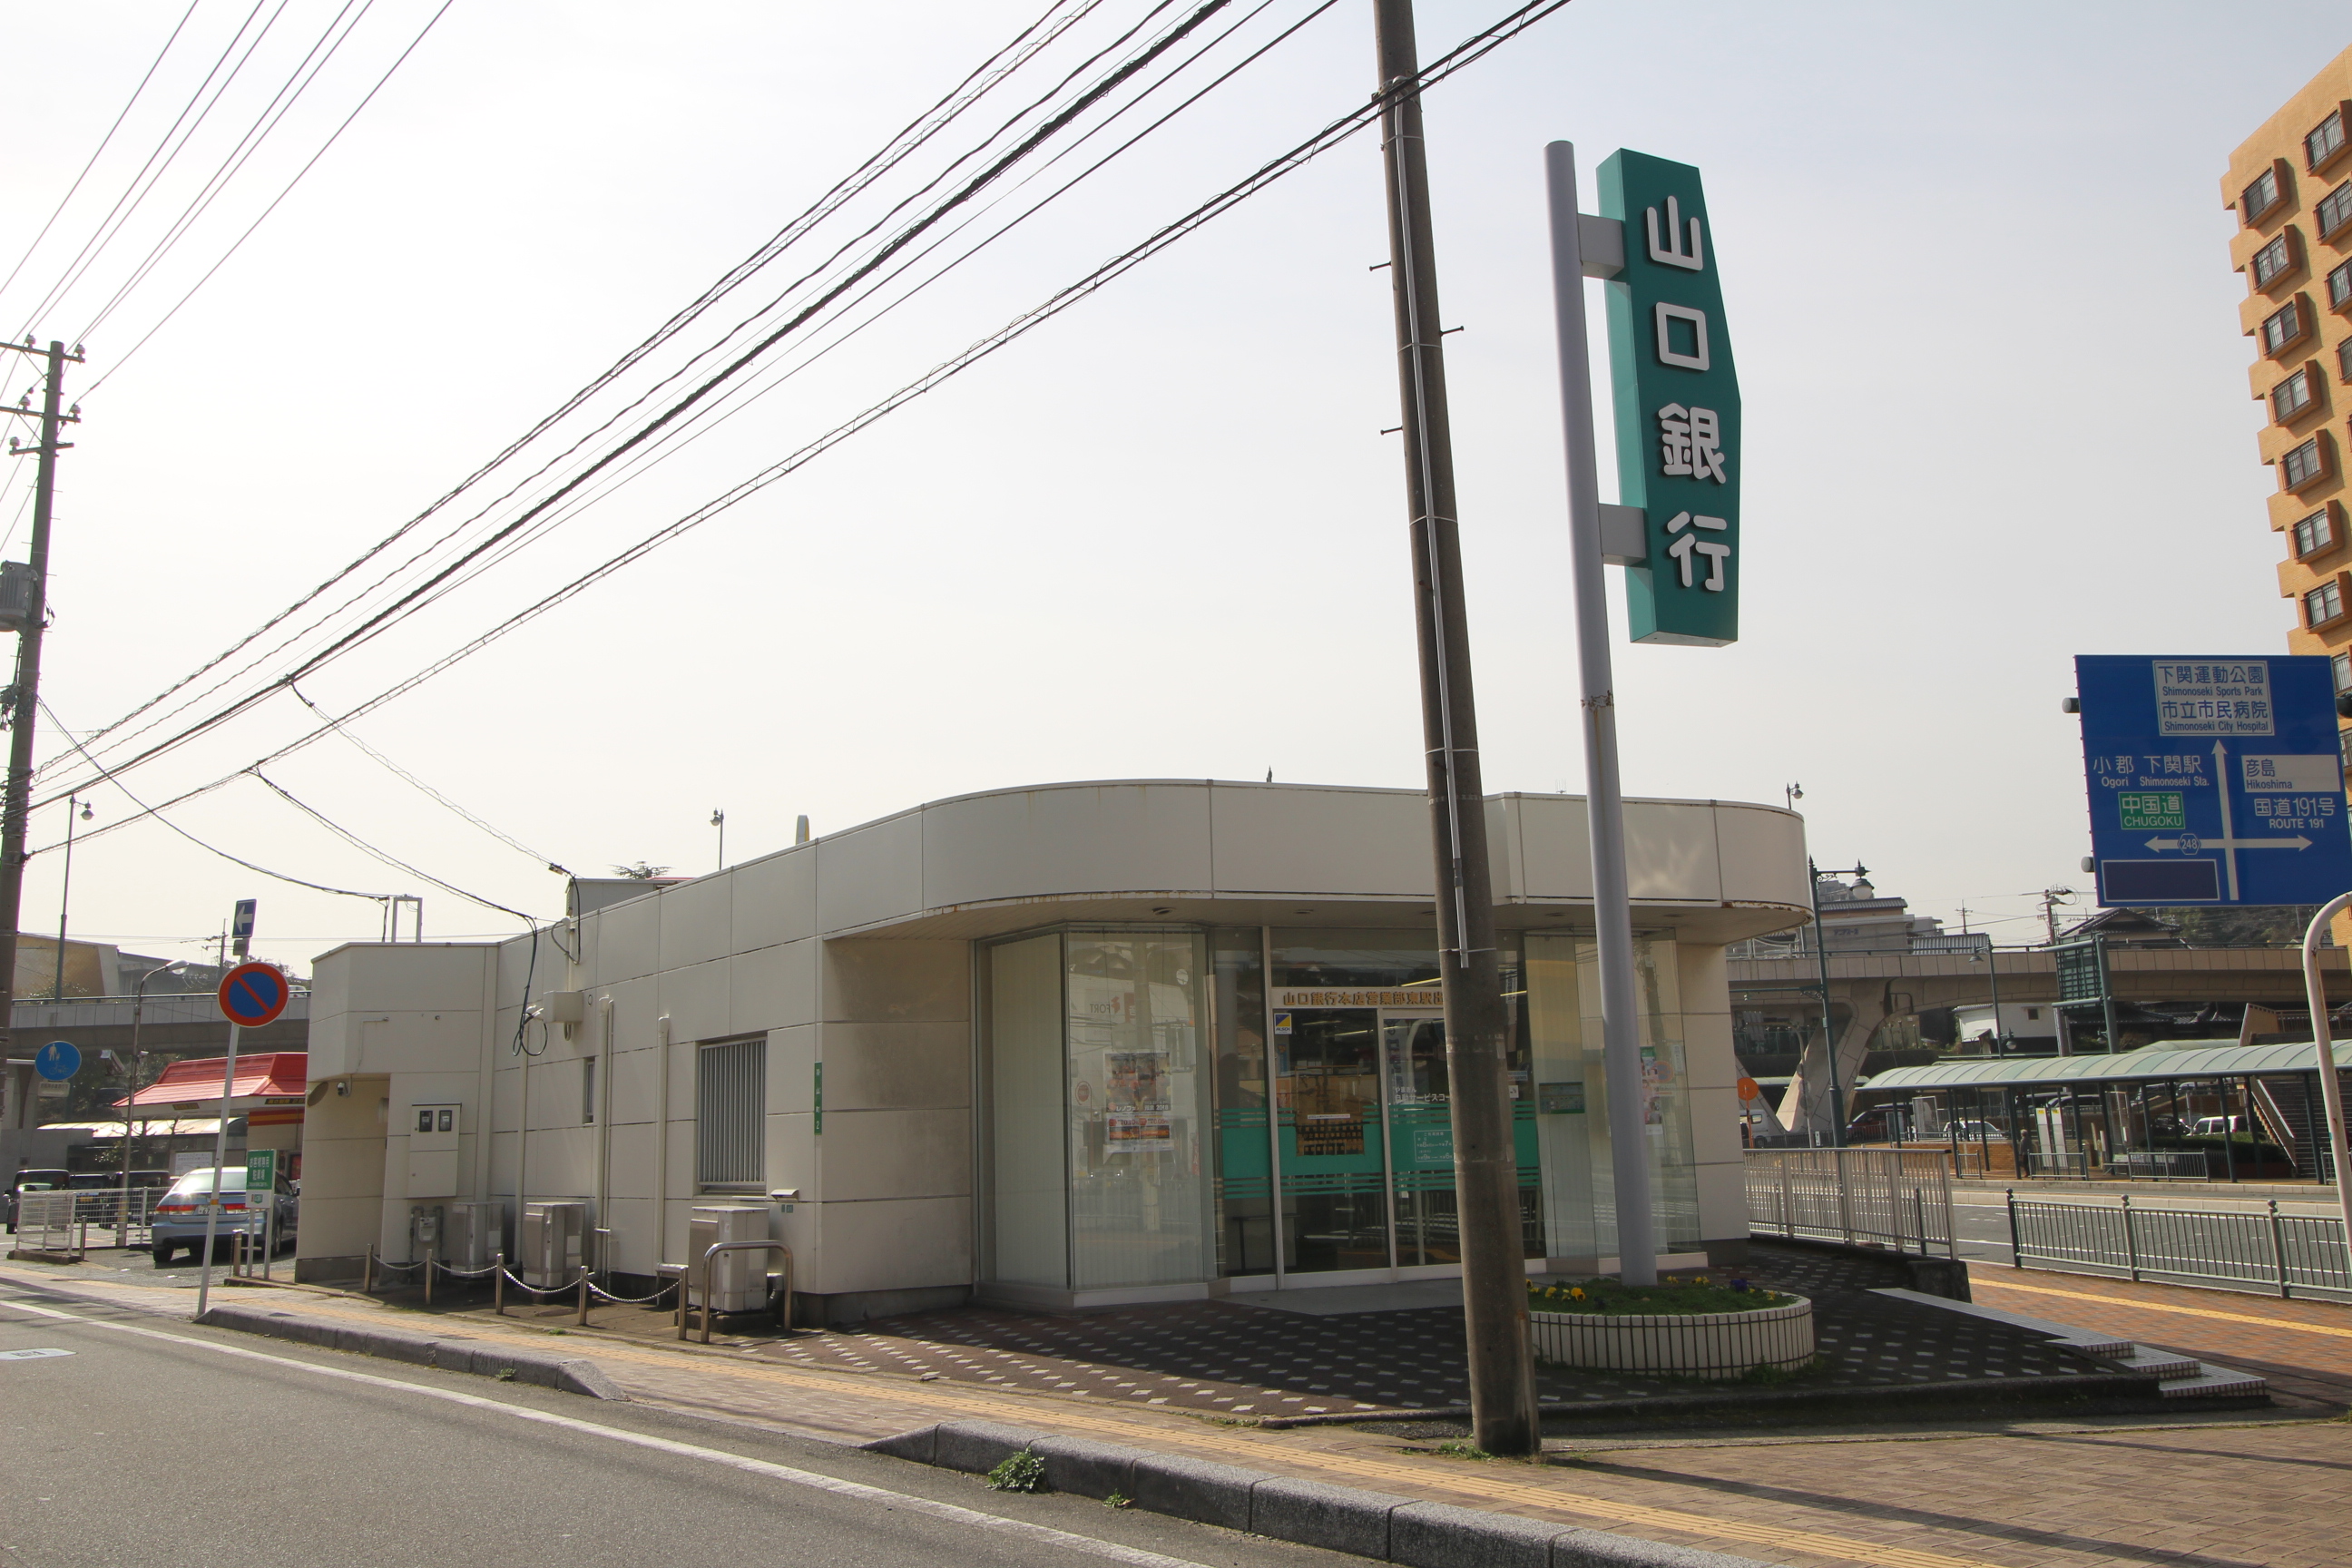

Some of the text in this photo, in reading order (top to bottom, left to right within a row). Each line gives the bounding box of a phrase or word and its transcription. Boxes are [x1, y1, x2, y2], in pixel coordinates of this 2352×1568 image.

[1646, 195, 1730, 592] 山口銀行
[2157, 665, 2265, 684] 下関運動公園
[2162, 686, 2263, 698] Shimonoseki Sports Park
[2161, 700, 2269, 720] 市立市民病院
[2164, 721, 2269, 733] Shimonoseki City Hospital
[2092, 755, 2202, 774] 小郡 下関駅
[2245, 759, 2276, 778] 彦島
[2101, 776, 2210, 789] Ogori Shimonoseki Sta.
[2246, 779, 2293, 789] Hikoshima
[2121, 794, 2181, 815] 中国道
[2254, 798, 2336, 817] 国道191号
[2123, 816, 2182, 828] CHUGOKU
[2269, 818, 2325, 829] ROUTE 191
[2180, 838, 2198, 849] 248
